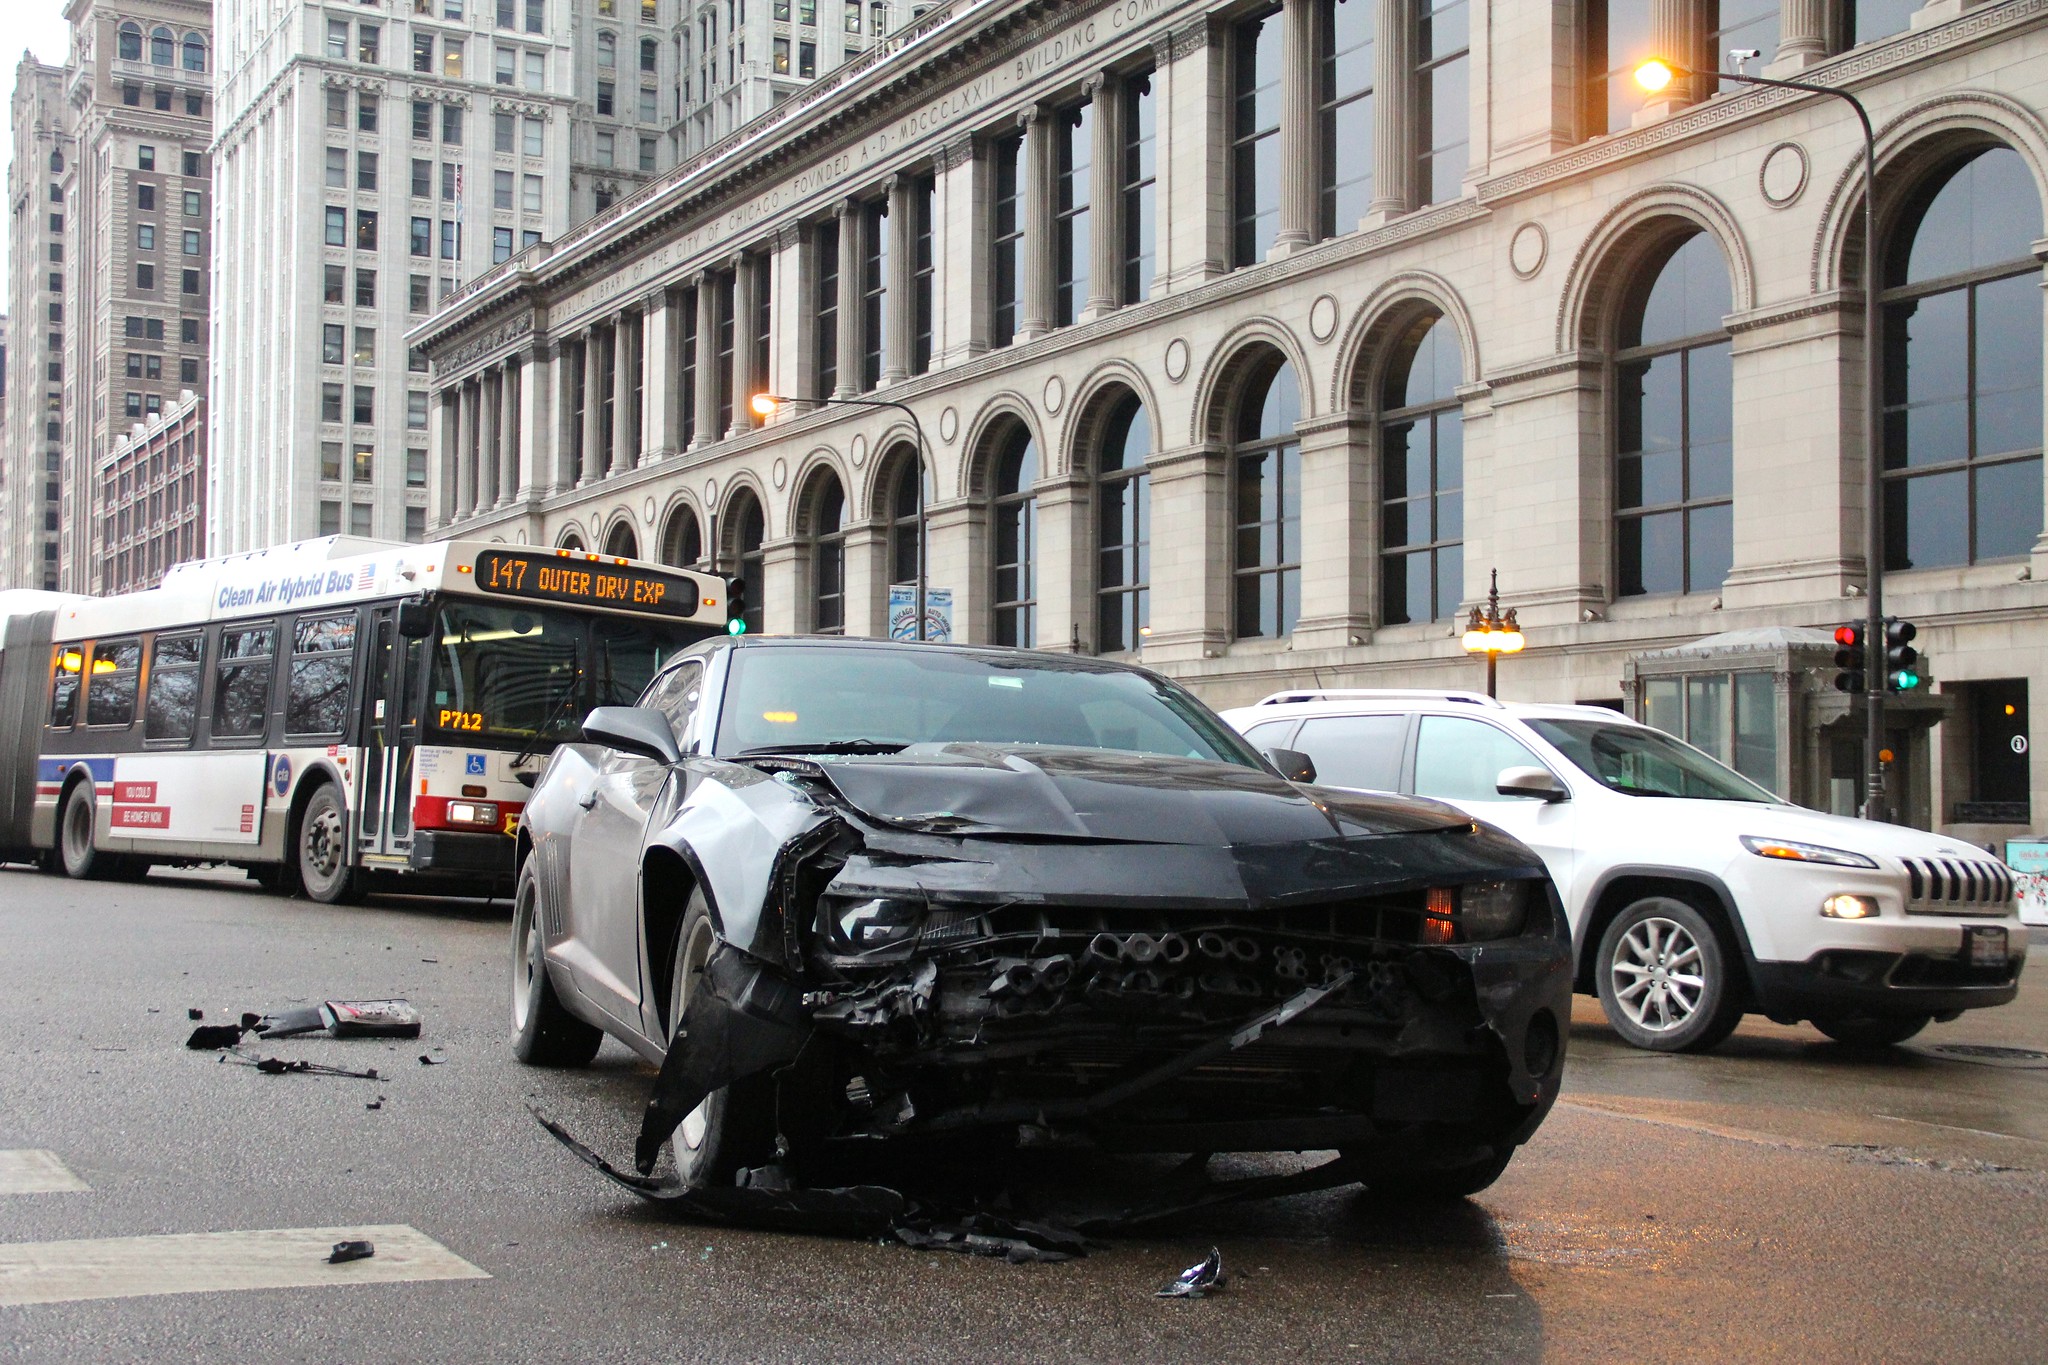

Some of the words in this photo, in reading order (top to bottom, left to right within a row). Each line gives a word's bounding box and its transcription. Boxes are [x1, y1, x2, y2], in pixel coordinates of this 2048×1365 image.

[591, 271, 627, 303] LIBRARY
[633, 263, 645, 281] OF
[652, 249, 669, 271] THE
[676, 233, 700, 258] CITY
[707, 222, 720, 241] OF
[728, 192, 779, 230] CHICAGO
[794, 155, 850, 198] FOVNDED
[1016, 23, 1096, 81] BVILDING
[218, 586, 254, 609] Clean
[255, 580, 277, 604] Air
[278, 572, 325, 605] Hybrid
[325, 570, 354, 594] Bus
[489, 557, 528, 590] 147
[538, 567, 591, 596] OUTER
[595, 575, 629, 600] DRV
[633, 580, 666, 605] EXP
[891, 607, 914, 625] CHICAGO
[927, 608, 941, 618] AUTO
[440, 709, 482, 731] P712
[277, 769, 289, 782] cta
